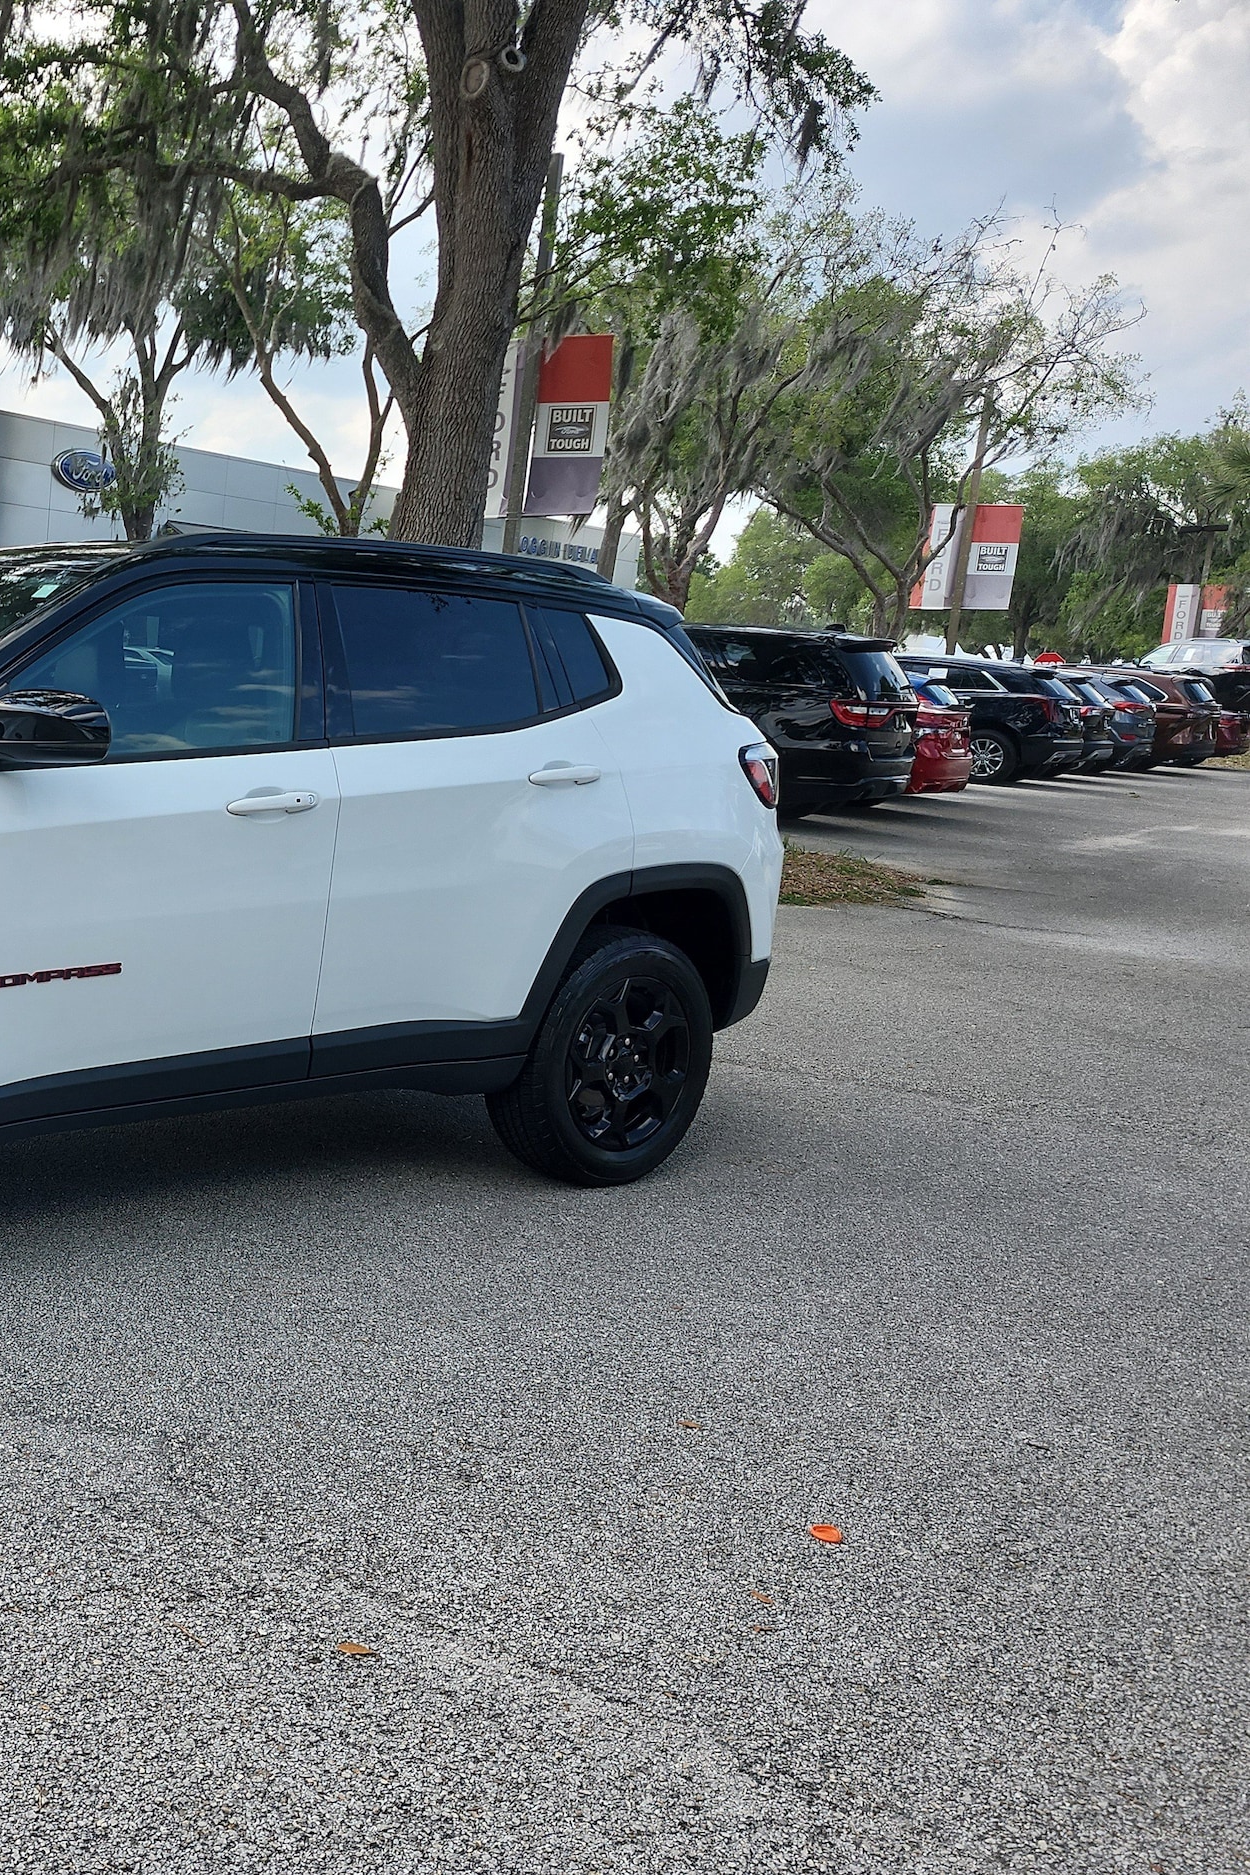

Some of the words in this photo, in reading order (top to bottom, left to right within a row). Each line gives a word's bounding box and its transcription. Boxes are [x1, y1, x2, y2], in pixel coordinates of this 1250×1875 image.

[552, 408, 593, 423] BUILT
[549, 438, 590, 450] TOUGH
[520, 535, 561, 559] OGGIN
[979, 546, 1008, 556] BUILT
[977, 563, 1005, 571] TOUGH
[1173, 600, 1187, 640] FORD
